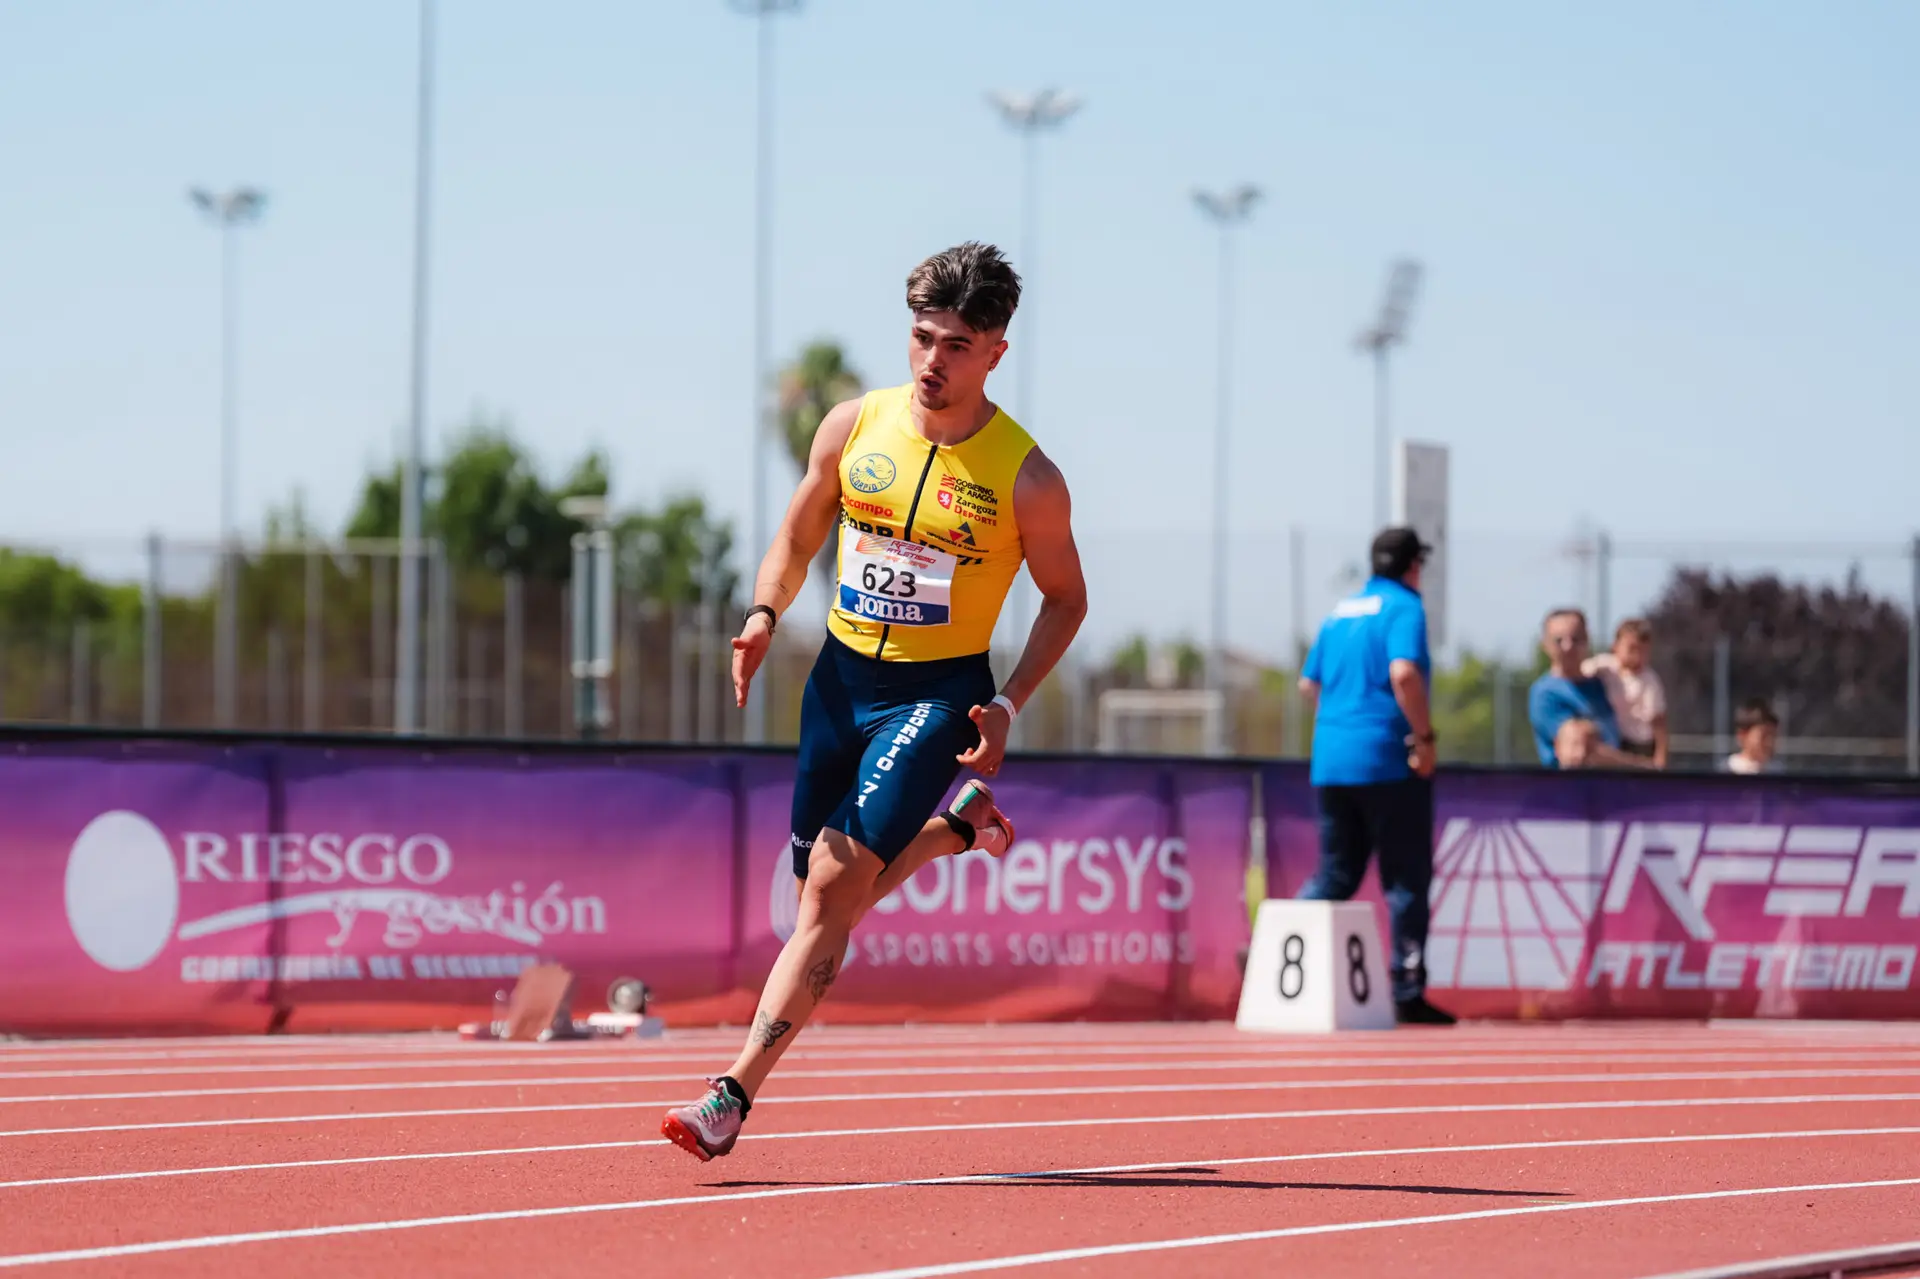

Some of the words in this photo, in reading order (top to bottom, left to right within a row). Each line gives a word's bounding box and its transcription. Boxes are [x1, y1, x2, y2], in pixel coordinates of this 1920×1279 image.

[954, 485, 965, 494] DE
[956, 478, 993, 496] GOBIERNO
[956, 496, 997, 516] Zaragoza
[862, 563, 917, 598] 623
[180, 832, 454, 885] RIESGO
[1602, 821, 1920, 940] RFEA
[326, 893, 358, 948] y
[383, 880, 608, 949] gestión
[863, 932, 993, 967] SPORTS
[1006, 930, 1196, 966] SOLUTIONS
[1280, 933, 1304, 999] 8
[1346, 932, 1371, 1005] 8
[1586, 941, 1917, 990] ATLETISMO
